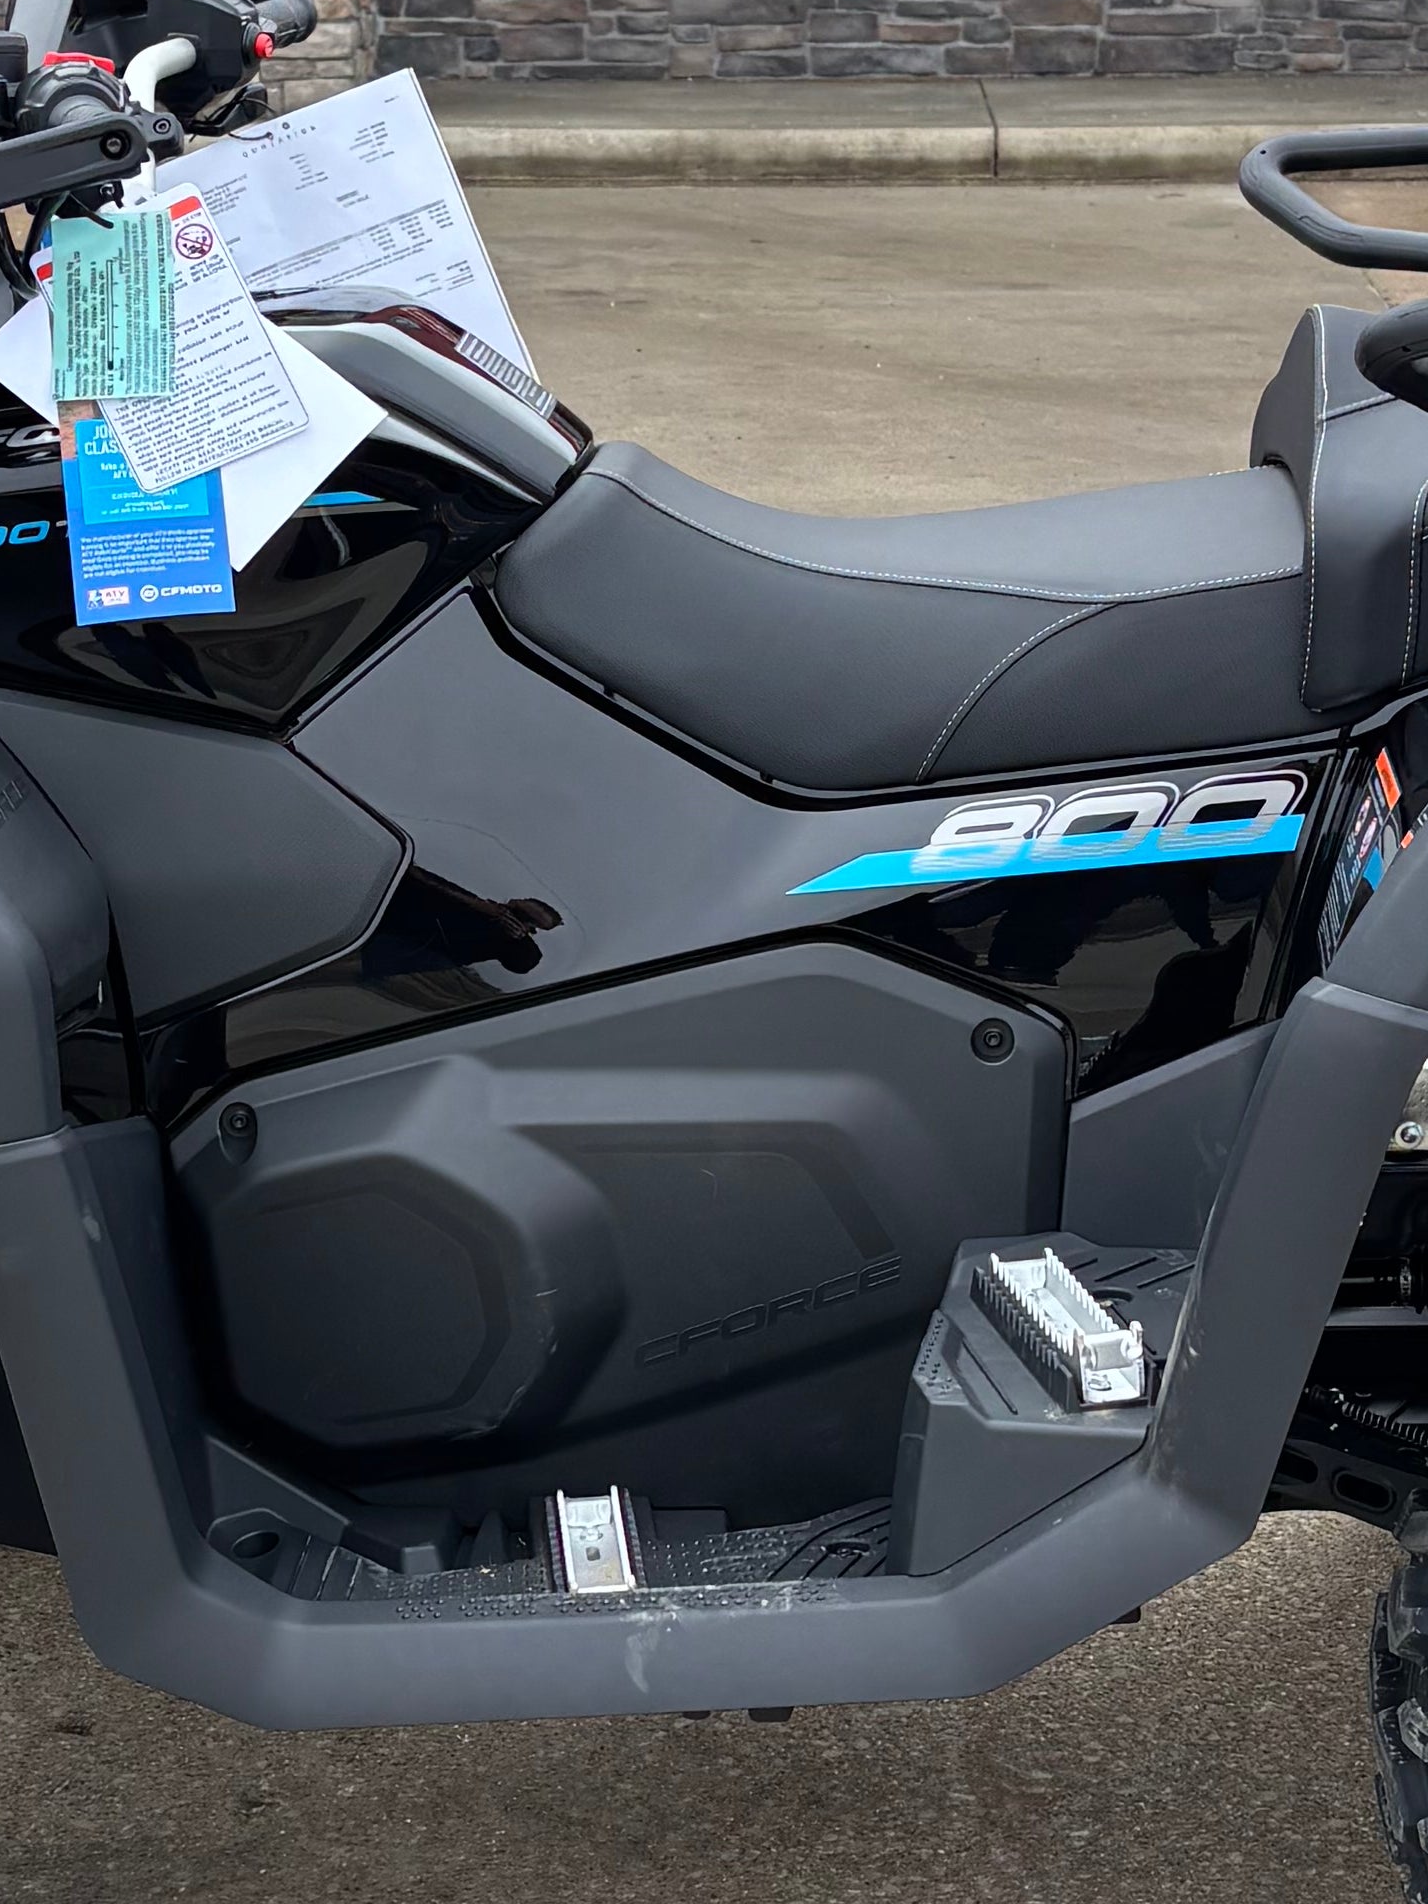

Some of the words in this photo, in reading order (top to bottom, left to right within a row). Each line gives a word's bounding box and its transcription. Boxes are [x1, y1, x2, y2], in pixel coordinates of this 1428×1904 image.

[160, 583, 223, 597] CFMOTO
[911, 770, 1309, 876] 800
[634, 1254, 903, 1369] CFORCE
